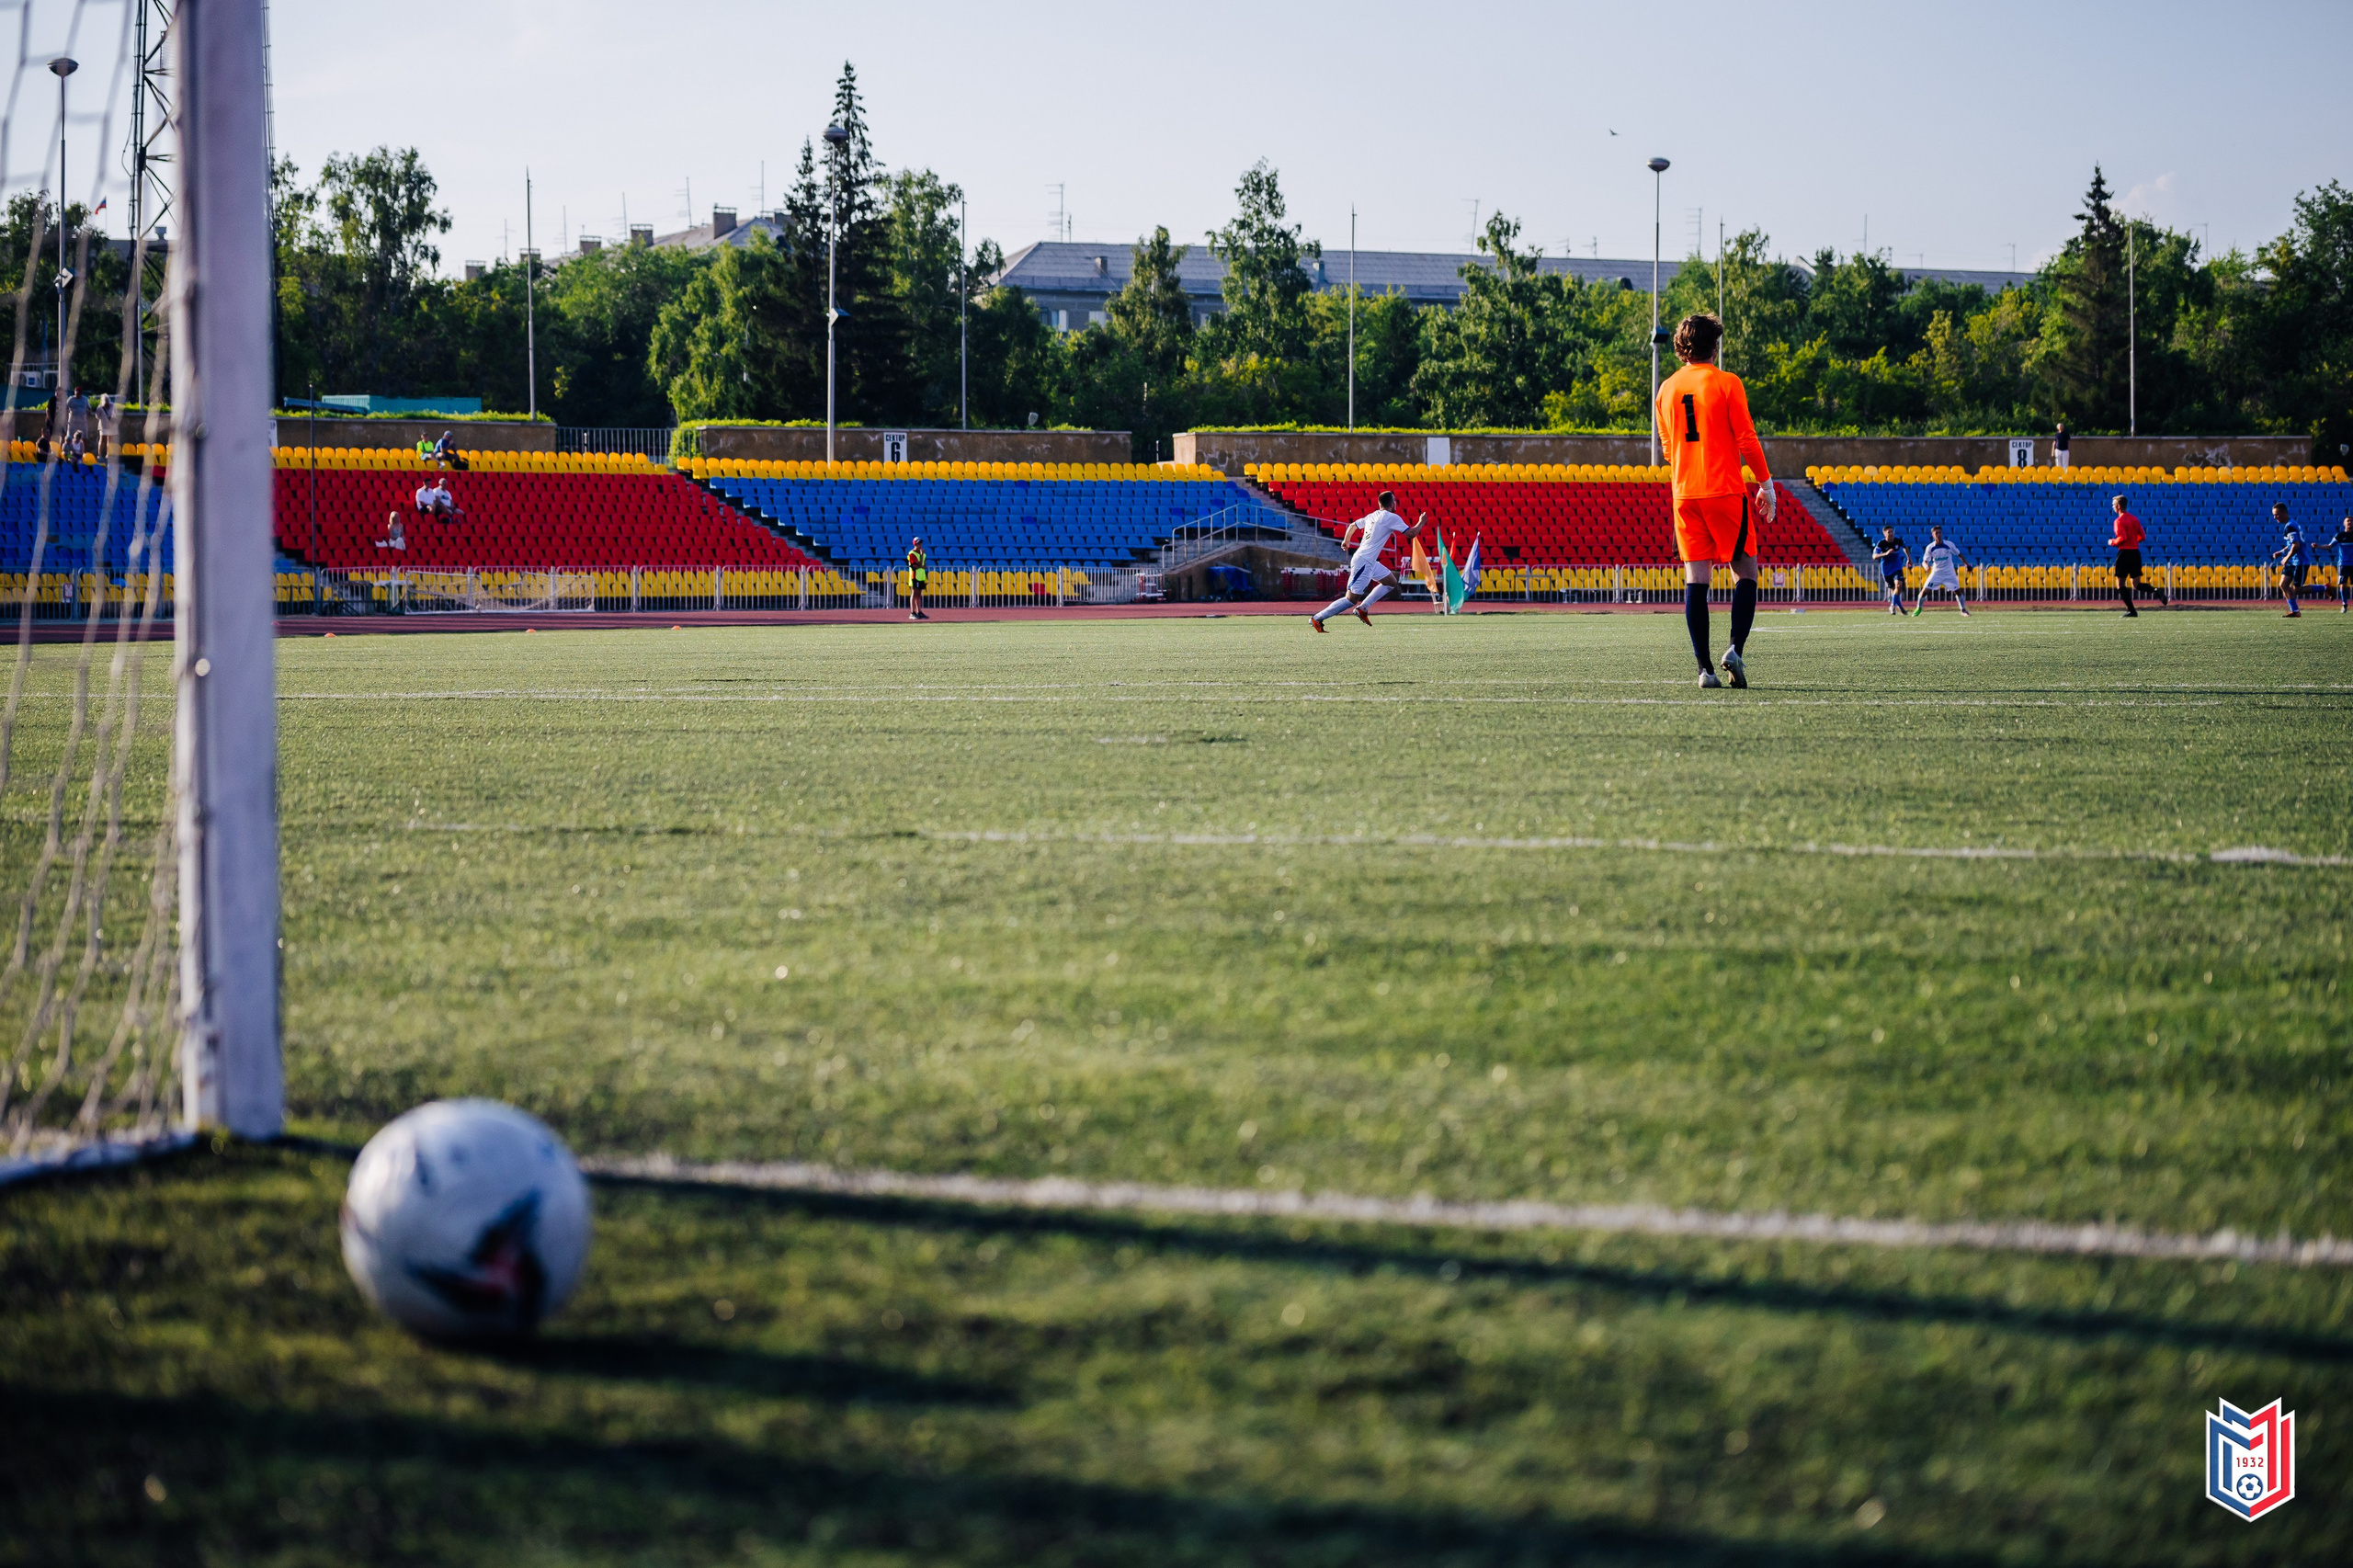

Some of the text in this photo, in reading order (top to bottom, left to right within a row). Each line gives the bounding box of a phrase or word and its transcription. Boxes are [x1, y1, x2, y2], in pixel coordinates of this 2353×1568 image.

[1681, 393, 1699, 442] 1
[891, 441, 901, 463] 6
[2018, 449, 2028, 468] 8
